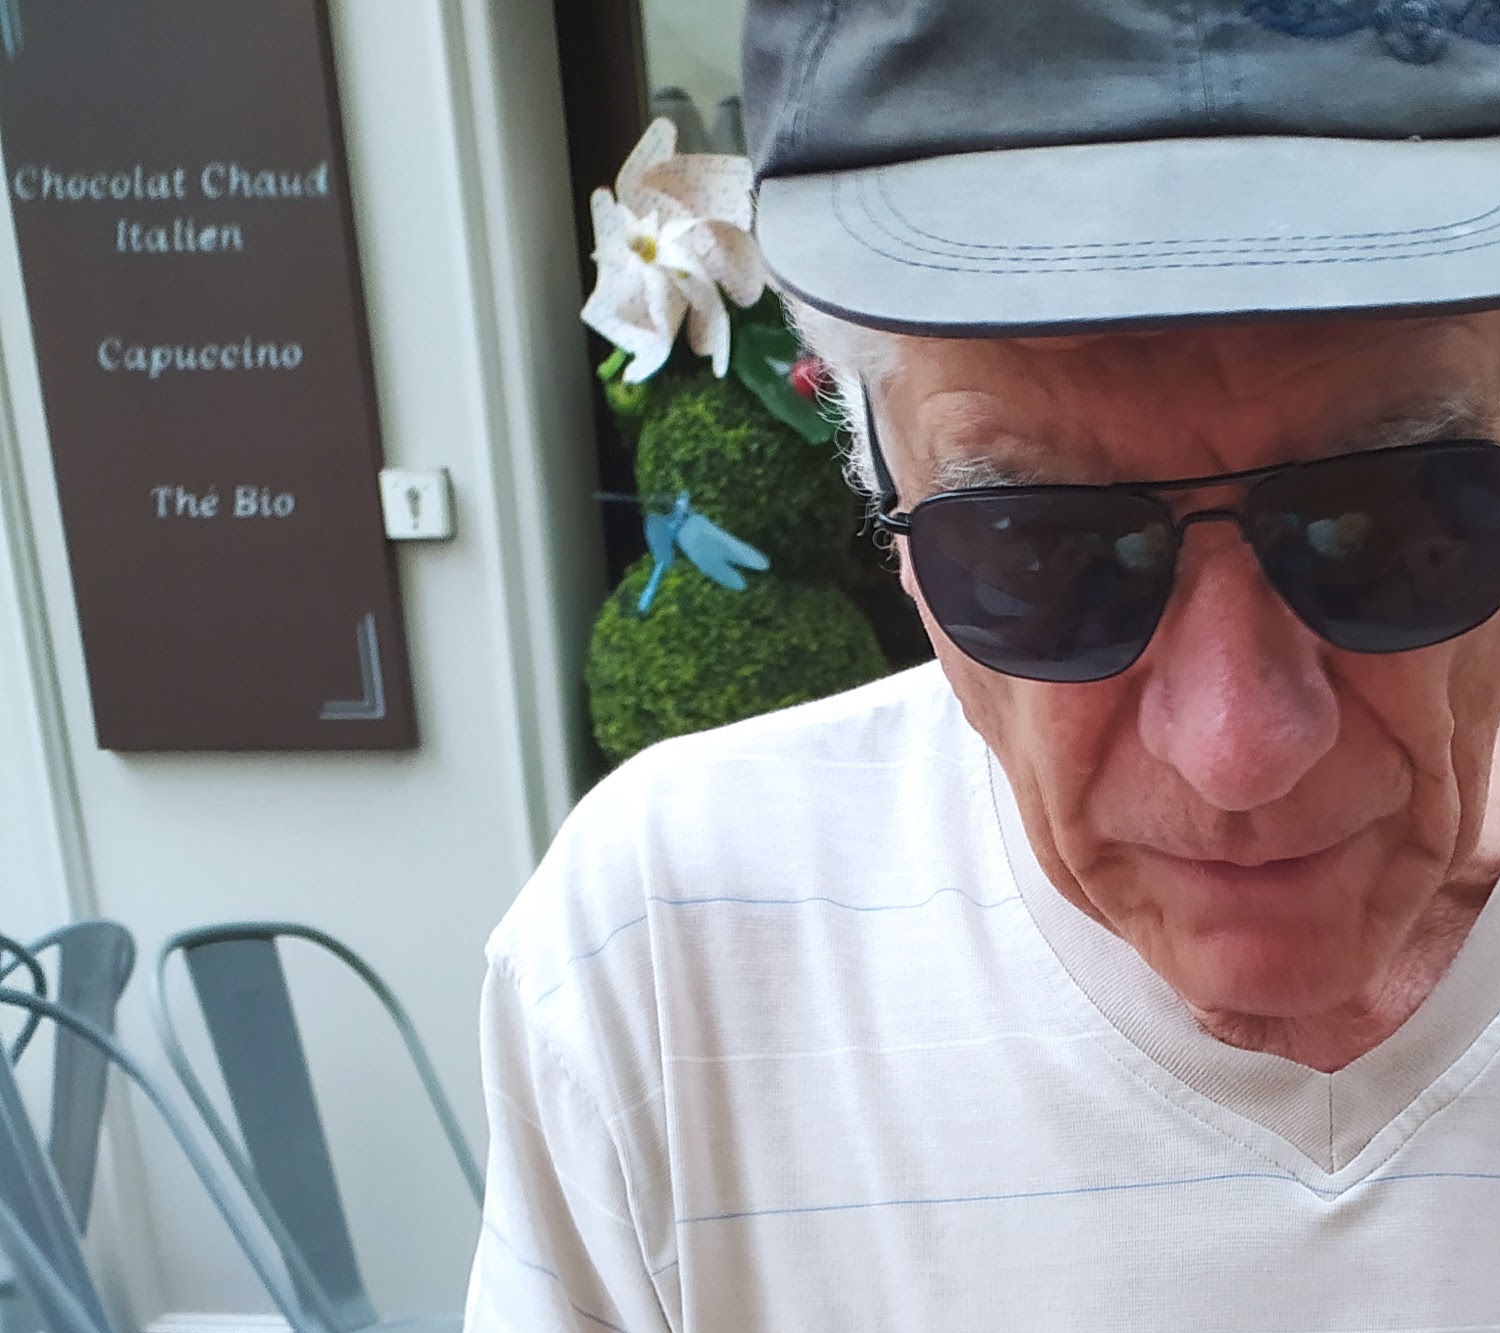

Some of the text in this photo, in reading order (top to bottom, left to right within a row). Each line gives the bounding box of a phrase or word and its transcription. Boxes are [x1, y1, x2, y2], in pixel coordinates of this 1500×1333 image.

[13, 159, 331, 200] Chocolat Chaud
[115, 217, 245, 254] Italien
[98, 336, 304, 379] Capuccino
[232, 484, 296, 518] Bio
